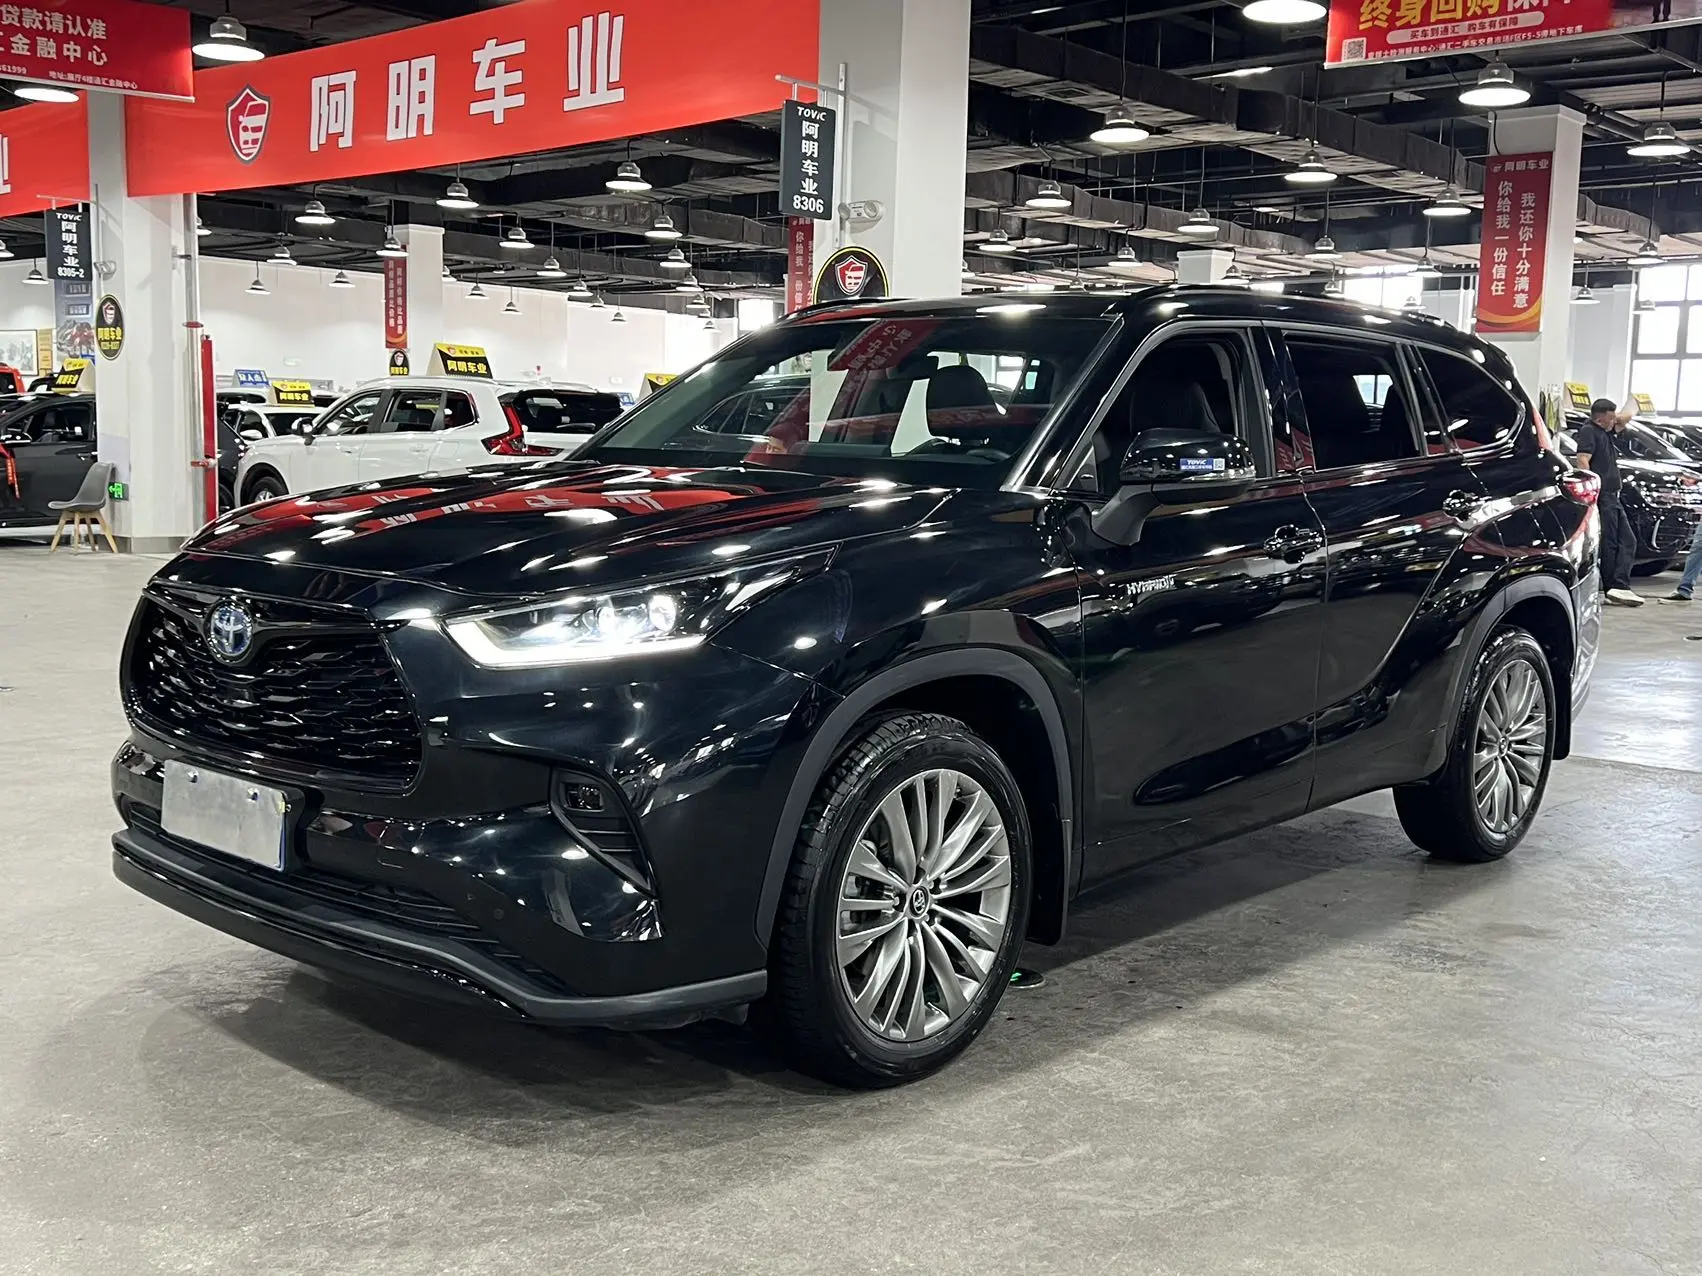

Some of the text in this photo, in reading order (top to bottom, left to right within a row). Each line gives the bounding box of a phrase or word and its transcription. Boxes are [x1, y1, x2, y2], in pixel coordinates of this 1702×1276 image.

[0, 4, 107, 40] 贷款请认准
[1410, 16, 1518, 40] 买车到通汇 购车有保障
[309, 12, 626, 153] 阿明车业
[797, 106, 827, 122] TOVIC
[800, 120, 819, 196] 阿明车业
[793, 194, 824, 214] 8306
[61, 221, 80, 268] 阿明车业
[1491, 180, 1513, 297] 你给我一份信任
[1513, 192, 1536, 309] 我还你十分满意
[57, 268, 85, 279] 8305-2
[447, 360, 487, 374] 阿明车业
[1126, 577, 1169, 595] HYBRID
